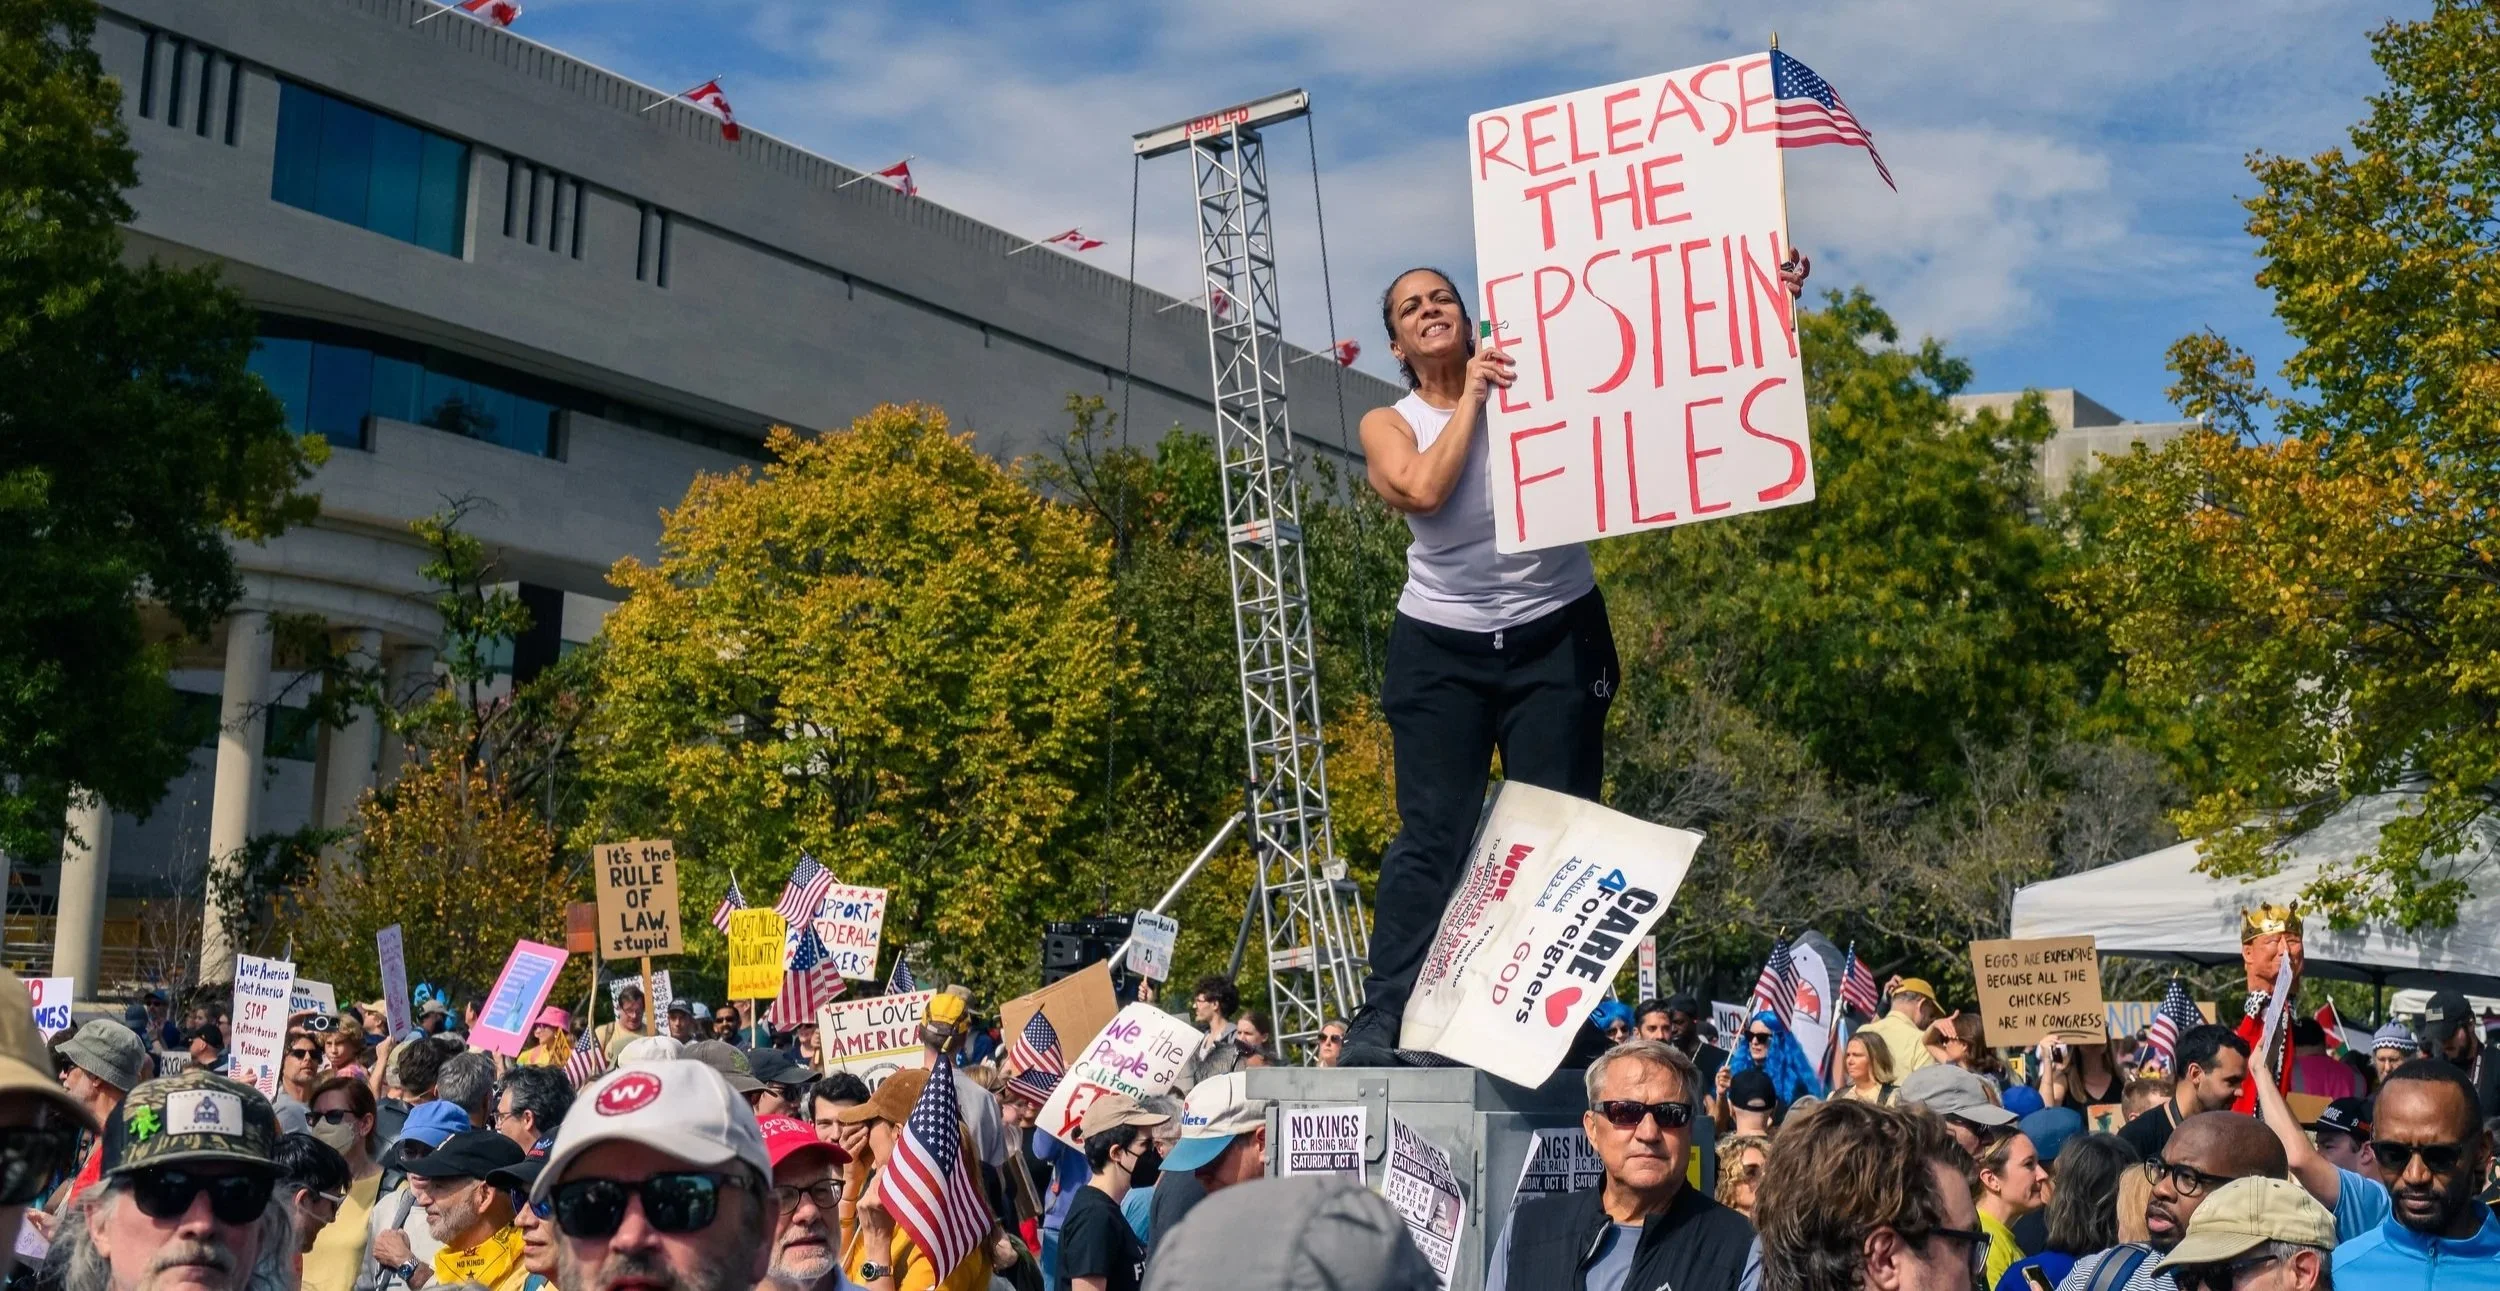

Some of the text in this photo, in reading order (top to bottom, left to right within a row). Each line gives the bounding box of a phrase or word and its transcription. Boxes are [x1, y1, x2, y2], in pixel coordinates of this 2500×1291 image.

[1184, 107, 1249, 139] APPLIED
[1477, 58, 1777, 180] RELEASE
[1522, 153, 1693, 251] THE
[1486, 231, 1798, 414] EPSTEIN
[1510, 378, 1806, 543] FILES
[606, 846, 671, 865] It's the
[610, 865, 663, 888] RULE
[1492, 843, 1535, 902] WOE
[626, 888, 652, 908] OF
[1553, 863, 1602, 914] Leviticus
[620, 910, 670, 932] LAW,
[813, 898, 873, 923] UPPORT
[613, 933, 669, 954] stupid
[817, 921, 876, 947] EDERAL
[1566, 887, 1659, 984] CARE
[239, 957, 289, 980] Love America
[831, 950, 868, 975] KERS
[1985, 946, 2093, 968] EGGS ARE EXPENSIVE
[1492, 941, 1531, 1006] GOD
[1987, 969, 2086, 988] BECAUSE ALL THE
[255, 983, 284, 999] America
[2008, 991, 2071, 1008] CHICKENS
[35, 1005, 68, 1028] NGS
[244, 1001, 268, 1020] STOP
[831, 1002, 922, 1031] I LOVE
[1999, 1013, 2102, 1029] ARE IN CONGRESS
[2108, 1002, 2144, 1038] NO
[240, 1041, 271, 1057] Takeover
[832, 1024, 924, 1058] AMERICA
[1106, 1018, 1184, 1065] We the
[1089, 1039, 1175, 1089] People of
[1292, 1115, 1359, 1138] NO KINGS
[1292, 1138, 1358, 1151] D.C. RISING RALLY
[1393, 1117, 1449, 1171] NO KINGS
[1292, 1155, 1333, 1168] SATURDAY,
[1334, 1154, 1350, 1168] OCT
[1393, 1153, 1432, 1184] SATURDAY,
[1433, 1173, 1447, 1190] OCT
[1528, 1160, 1570, 1173] SING RALLY
[1576, 1159, 1604, 1171] D.C. RIS
[1545, 1177, 1559, 1190] OCT
[1576, 1174, 1600, 1188] SATUR
[466, 1259, 485, 1267] KINGS
